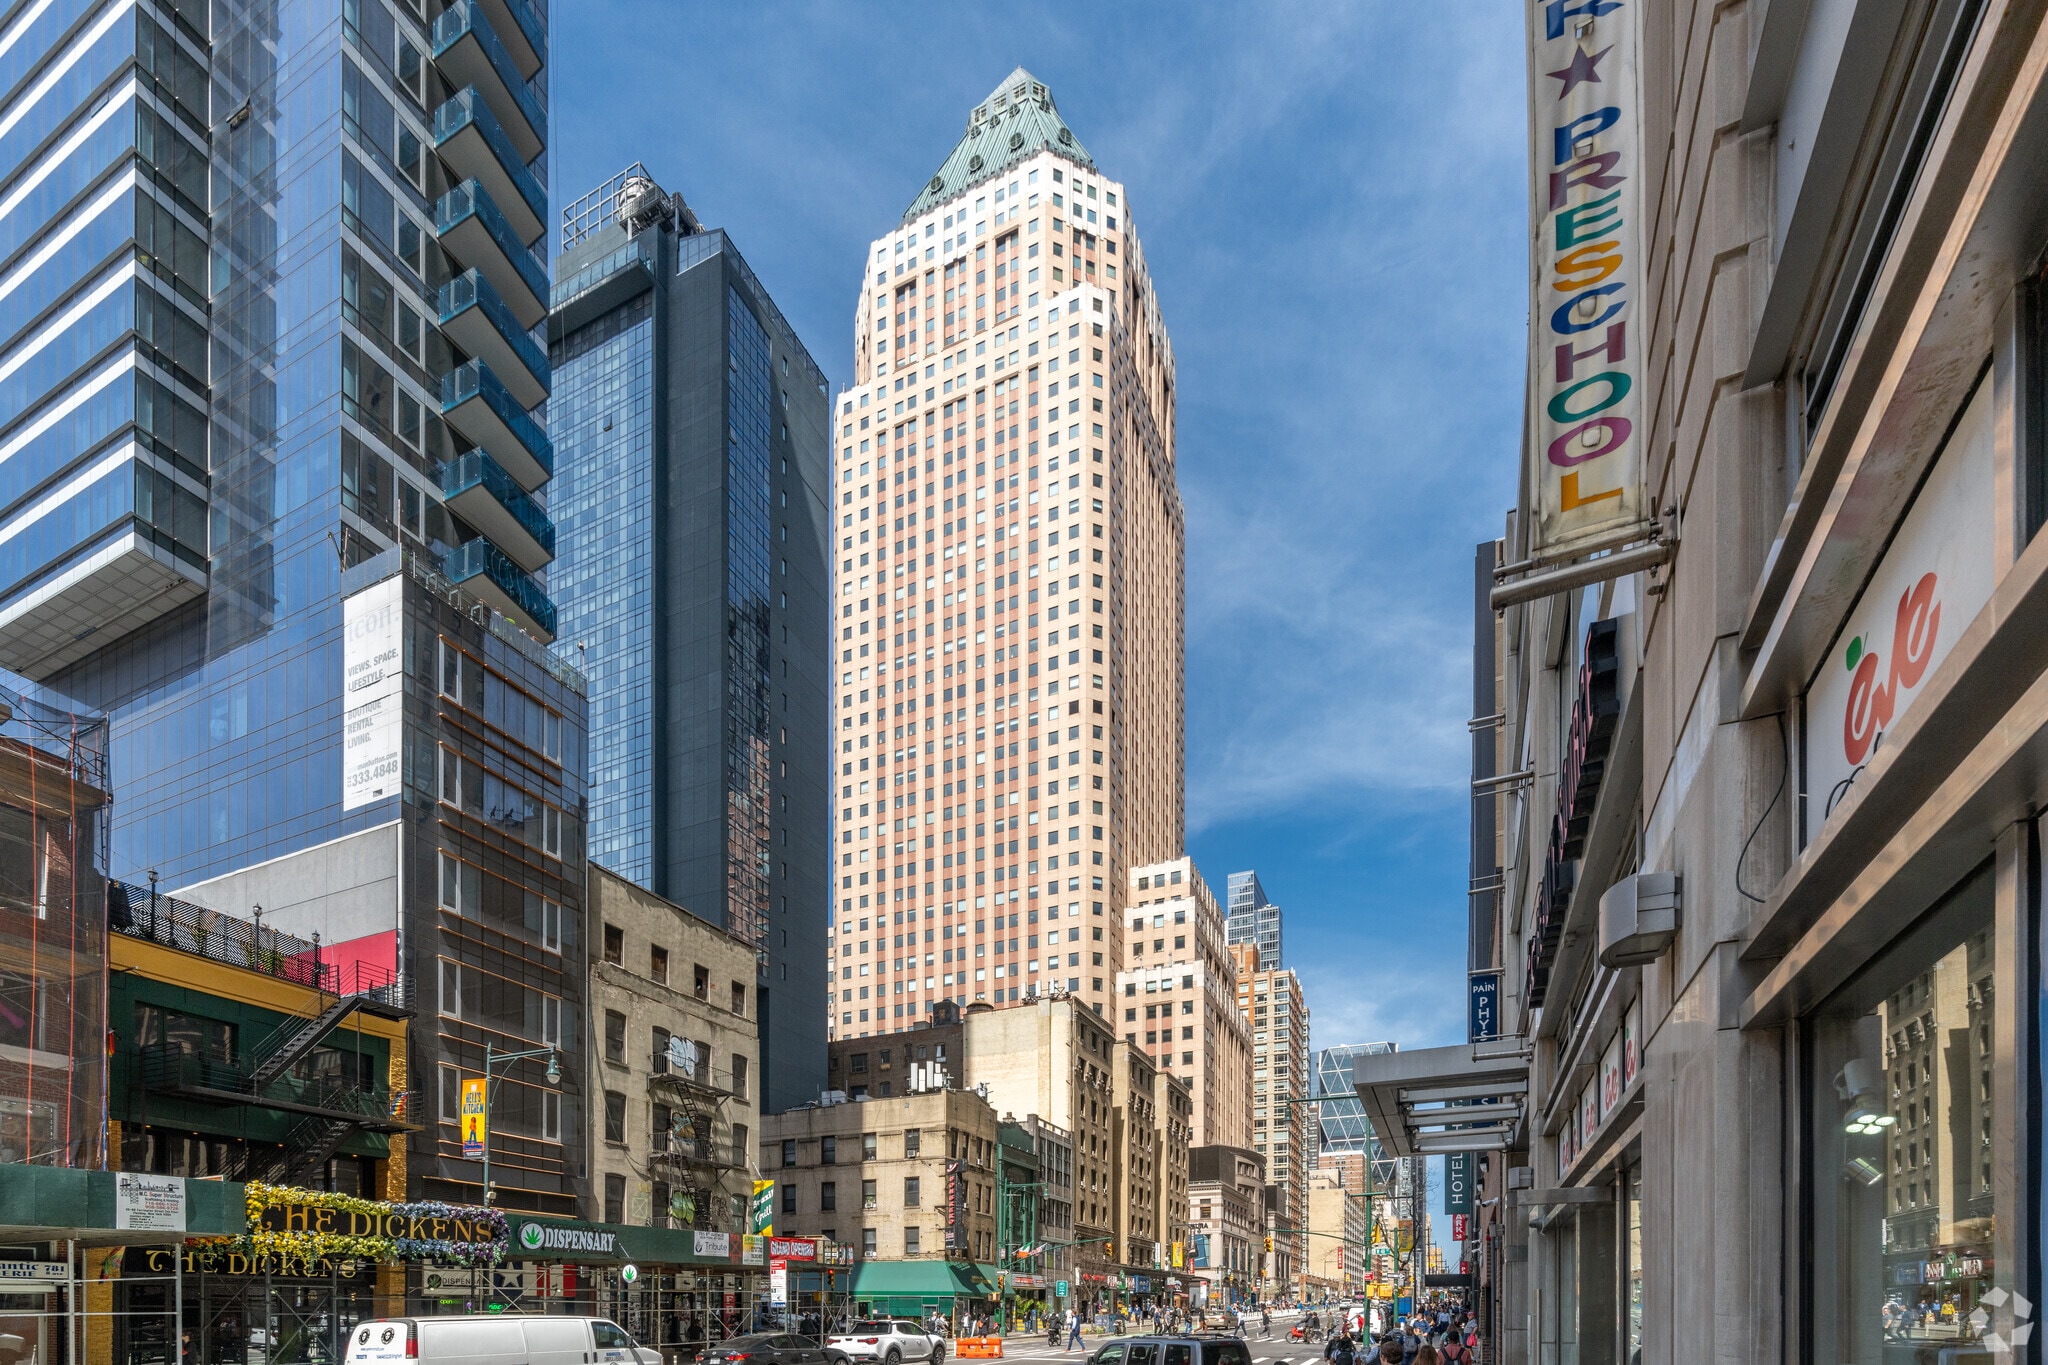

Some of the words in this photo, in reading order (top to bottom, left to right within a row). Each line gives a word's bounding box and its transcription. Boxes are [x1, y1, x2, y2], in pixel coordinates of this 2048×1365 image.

[1548, 106, 1632, 513] PRESCHOOL
[348, 659, 371, 678] VIEWS.
[373, 648, 399, 667] SPACE.
[347, 717, 374, 735] RENTAL
[347, 734, 371, 749] LIVING.
[1452, 1153, 1463, 1204] HOTEL
[260, 1204, 337, 1235] THE
[347, 1211, 493, 1243] DICKENS
[544, 1228, 615, 1252] DISPENSARY
[705, 1242, 728, 1251] Tribute
[146, 1250, 218, 1274] THE
[228, 1253, 356, 1279] DICKENS
